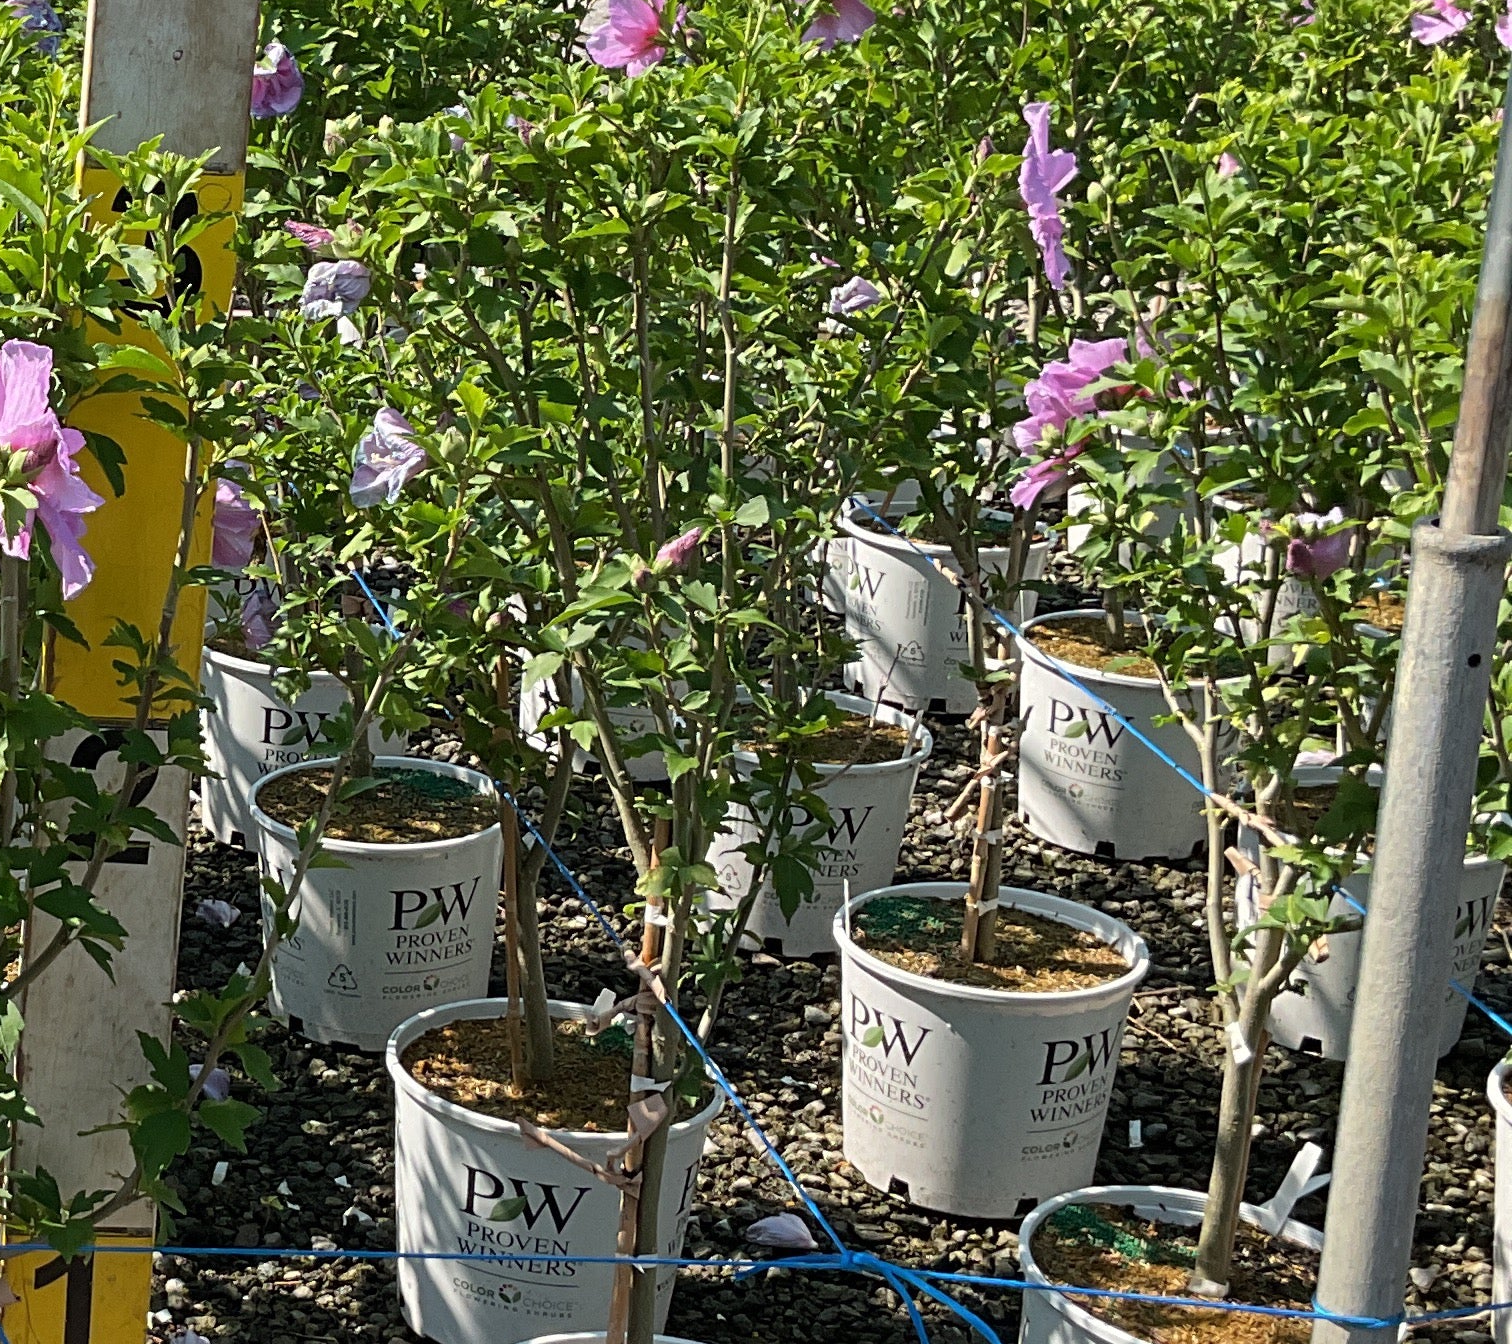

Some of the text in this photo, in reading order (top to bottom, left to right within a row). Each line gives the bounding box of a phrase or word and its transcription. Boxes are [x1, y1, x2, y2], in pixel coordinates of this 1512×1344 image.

[1048, 696, 1134, 749] PW
[1044, 749, 1123, 782] WINNERS
[1050, 738, 1118, 765] PROVEN
[388, 876, 482, 931] PW
[385, 940, 473, 966] WINNERS
[396, 924, 470, 949] PROVEN
[383, 984, 421, 993] COLOR
[849, 992, 933, 1067] PW
[852, 1045, 918, 1089] PROVEN
[1036, 1022, 1122, 1086] PW
[847, 1060, 925, 1110] WINNERS
[1041, 1072, 1108, 1105] PROVEN
[1029, 1092, 1107, 1123] WINNERS
[460, 1163, 592, 1235] PW
[468, 1221, 570, 1257] PROVEN
[453, 1277, 496, 1299] COLOR
